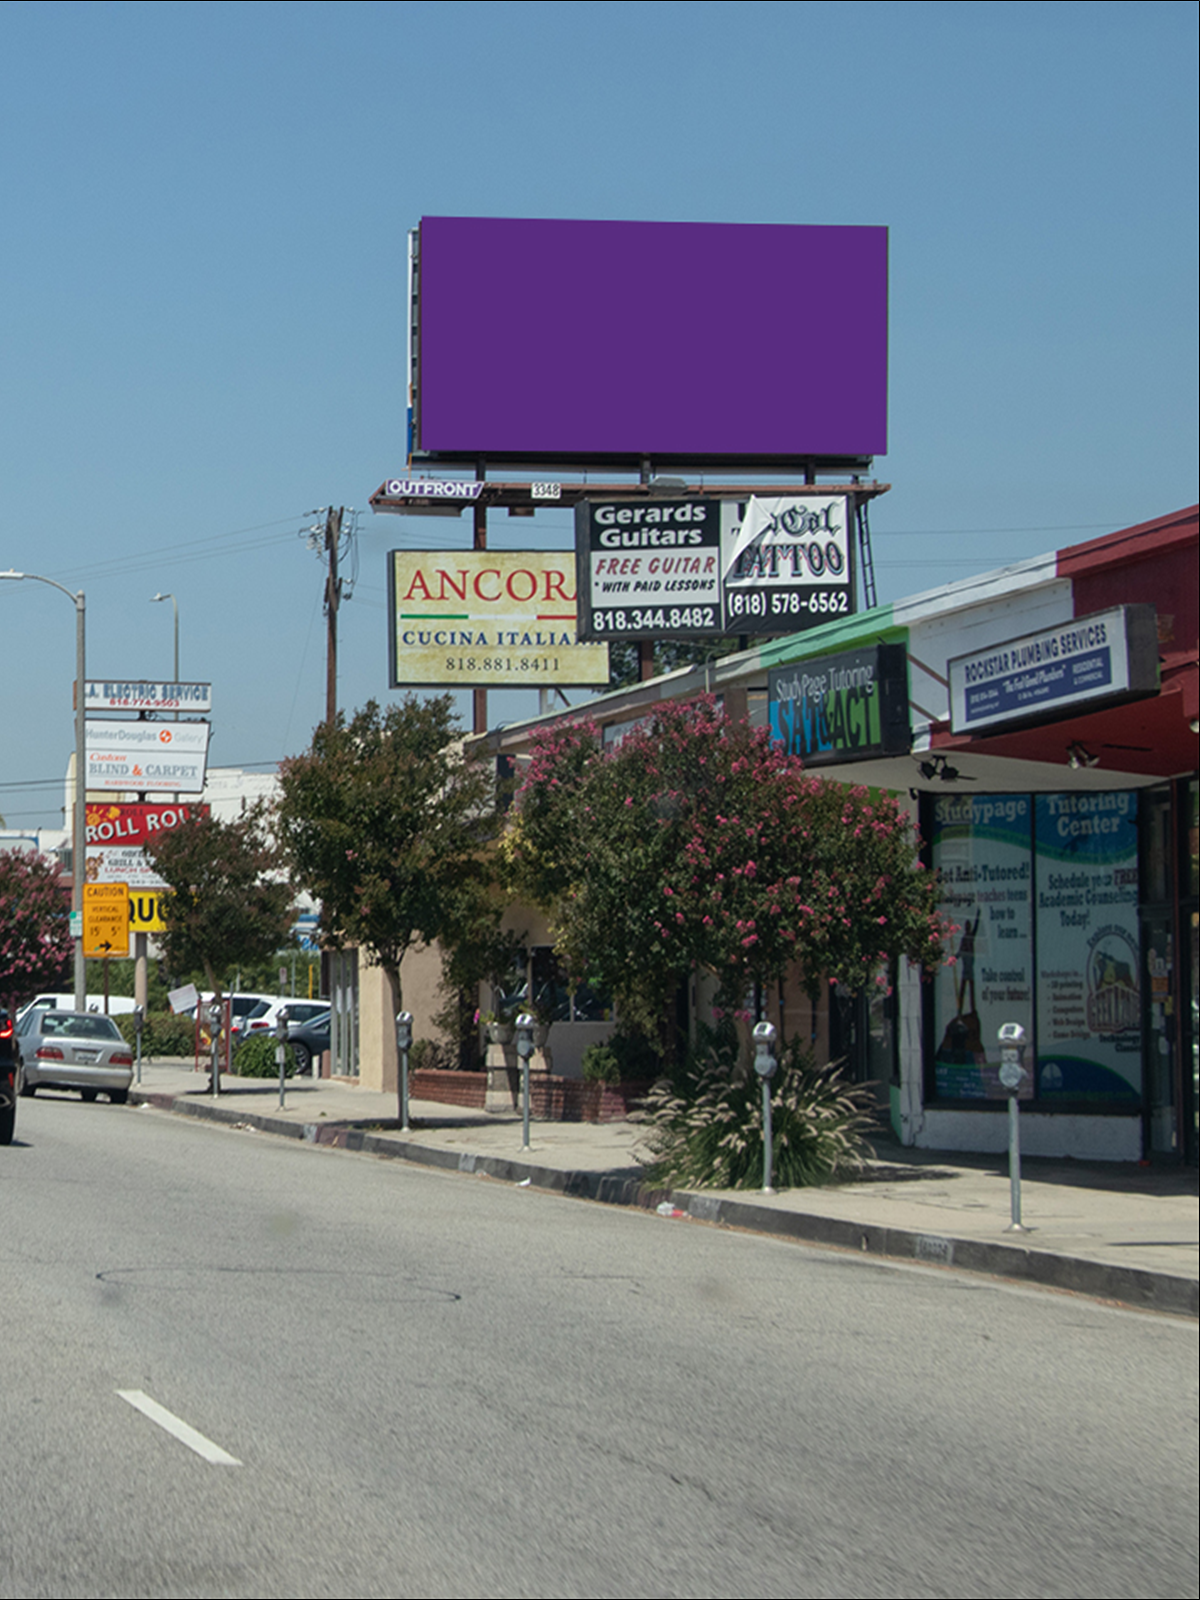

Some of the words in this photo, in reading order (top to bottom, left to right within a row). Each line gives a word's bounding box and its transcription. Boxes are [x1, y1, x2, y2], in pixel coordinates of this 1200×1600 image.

[388, 481, 478, 497] OUTFRONT
[532, 482, 560, 497] 3348
[594, 503, 707, 525] Gerards
[599, 526, 702, 548] Guitars
[595, 557, 642, 576] FREE
[649, 555, 716, 575] GUITAR
[402, 569, 577, 602] ANCOR
[633, 580, 661, 593] PAID
[664, 578, 715, 592] LESSONS
[728, 591, 767, 617] (818)
[772, 591, 848, 615] 578-6562
[593, 607, 715, 631] 818.344.8482
[402, 630, 488, 646] CUCINA
[497, 631, 603, 646] ITALIA
[964, 653, 1010, 685] ROCKSTAR
[1010, 637, 1059, 671] PLUMBING
[1060, 623, 1107, 656] SERVICES
[445, 658, 560, 672] 818.881.8411
[103, 683, 156, 699] ELECTRIC
[162, 684, 208, 701] SERVICE
[776, 673, 802, 706] Study
[801, 674, 827, 703] Page
[828, 659, 874, 694] Tutoring
[89, 763, 130, 776] BLIND
[132, 764, 143, 777] &
[145, 764, 198, 777] CARPET
[935, 799, 1027, 824] Studypage
[1047, 793, 1130, 815] Tutoring
[85, 818, 140, 843] ROLL
[1057, 815, 1120, 837] Center
[1048, 871, 1090, 890] Schedule
[87, 887, 124, 898] CAUTION
[1038, 889, 1084, 908] Academic
